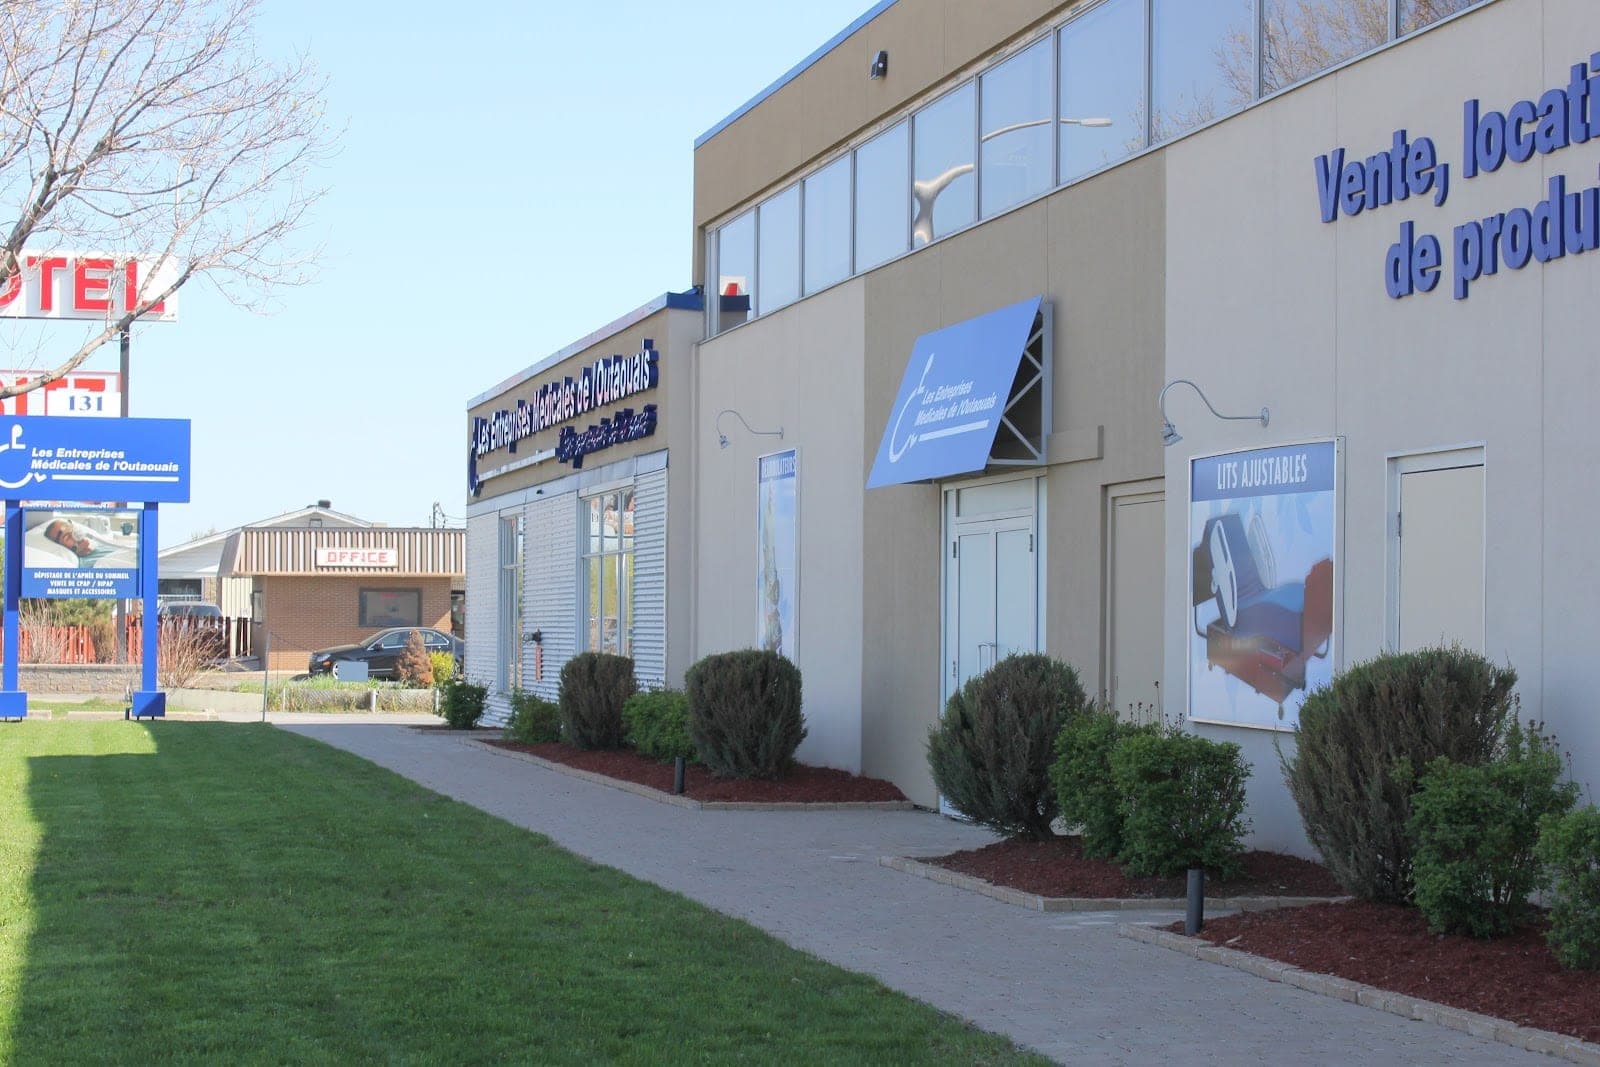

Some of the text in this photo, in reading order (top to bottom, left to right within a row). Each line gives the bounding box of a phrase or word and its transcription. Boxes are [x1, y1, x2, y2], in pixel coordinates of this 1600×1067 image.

[1314, 129, 1449, 223] Vente,
[1385, 175, 1600, 299] de produ
[69, 395, 103, 411] 131
[922, 390, 935, 404] Les
[32, 448, 125, 459] Les Entreprises
[31, 459, 179, 472] Médicales de l'Outaouais
[1217, 454, 1307, 489] LITS AJUSTABLES
[327, 551, 388, 563] OFFICE
